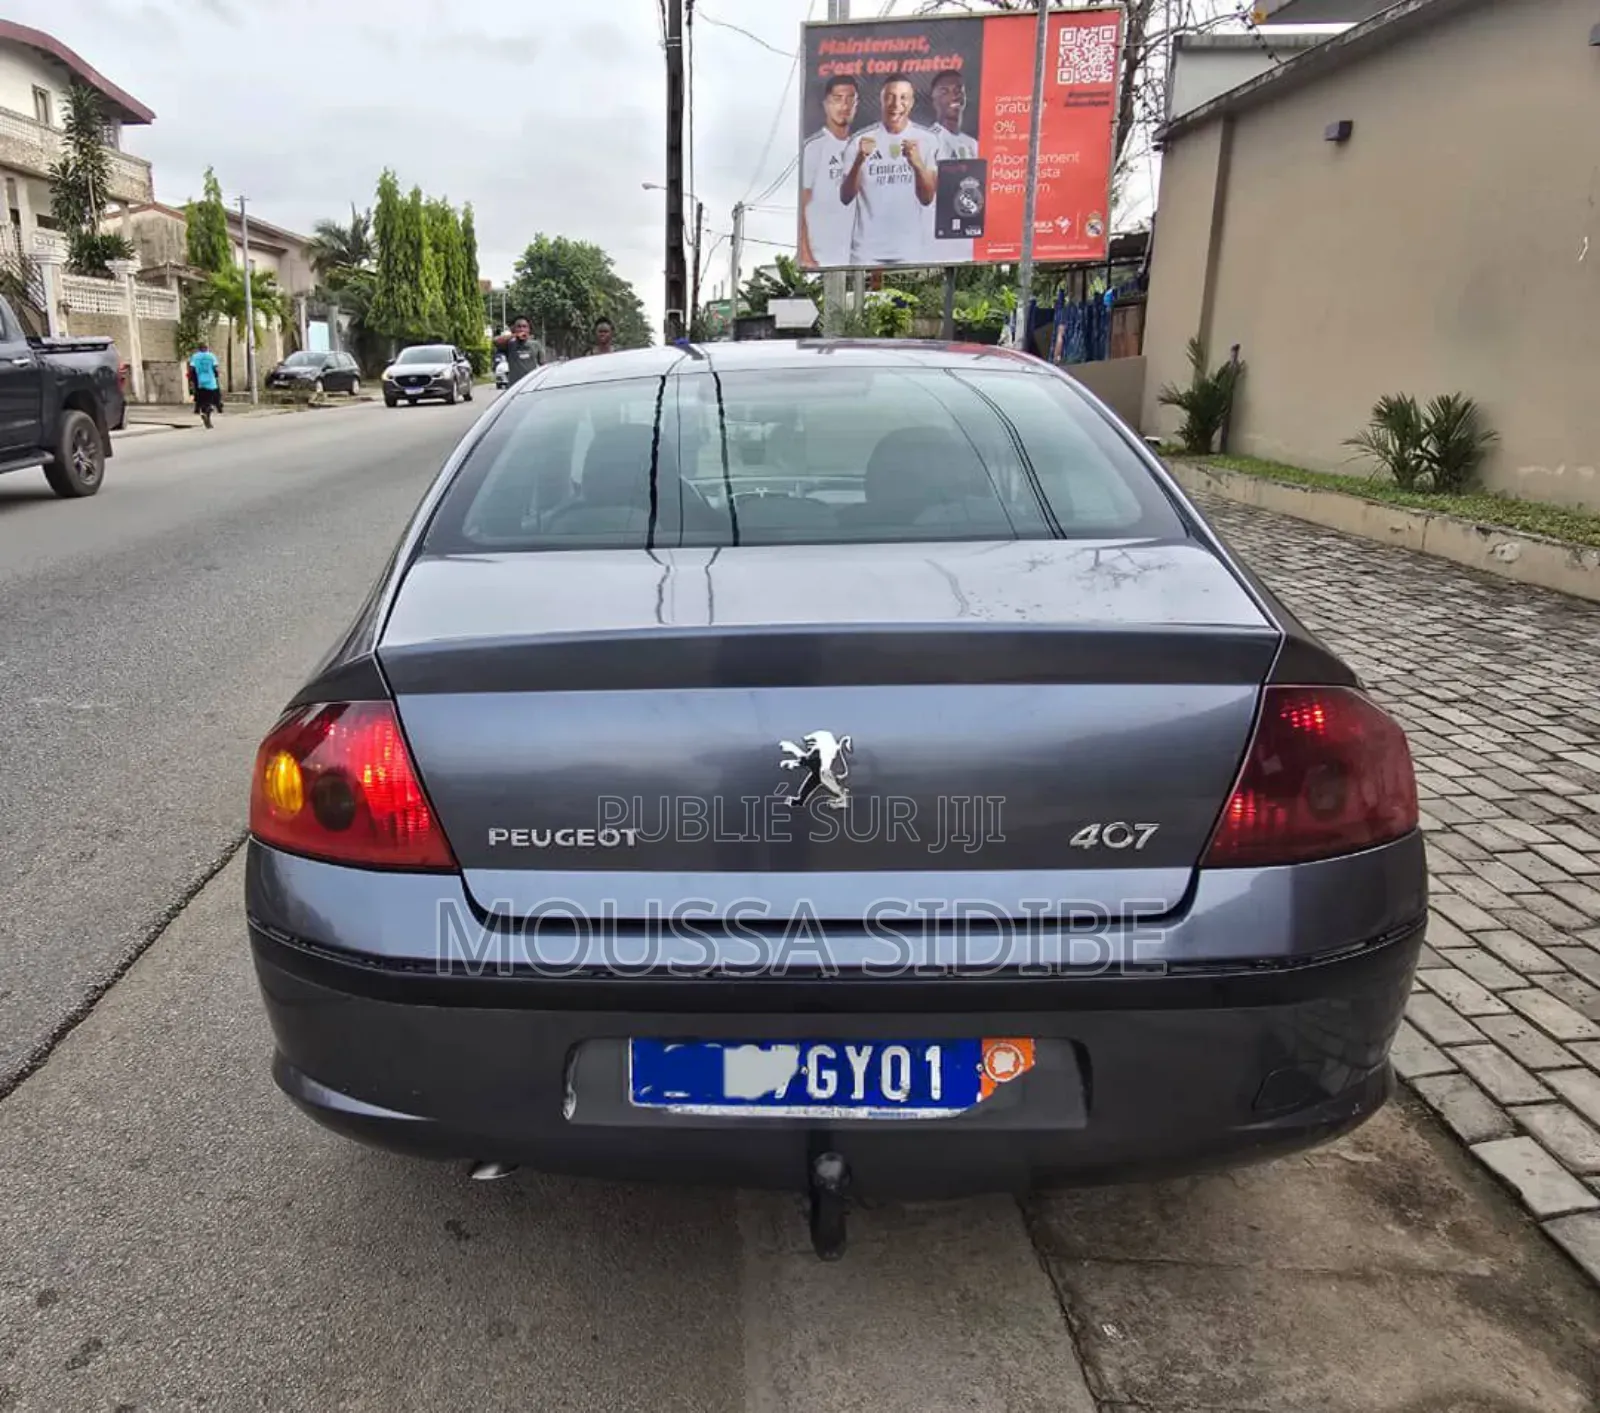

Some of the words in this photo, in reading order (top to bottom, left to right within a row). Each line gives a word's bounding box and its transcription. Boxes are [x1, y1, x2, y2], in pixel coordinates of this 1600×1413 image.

[818, 35, 930, 55] Maintenant,
[818, 59, 863, 76] c'est
[866, 57, 898, 74] ton
[901, 54, 964, 72] match
[993, 119, 1016, 133] 0%
[989, 180, 1051, 195] Premm
[488, 828, 640, 847] PEUGEOT
[1069, 821, 1160, 850] 407
